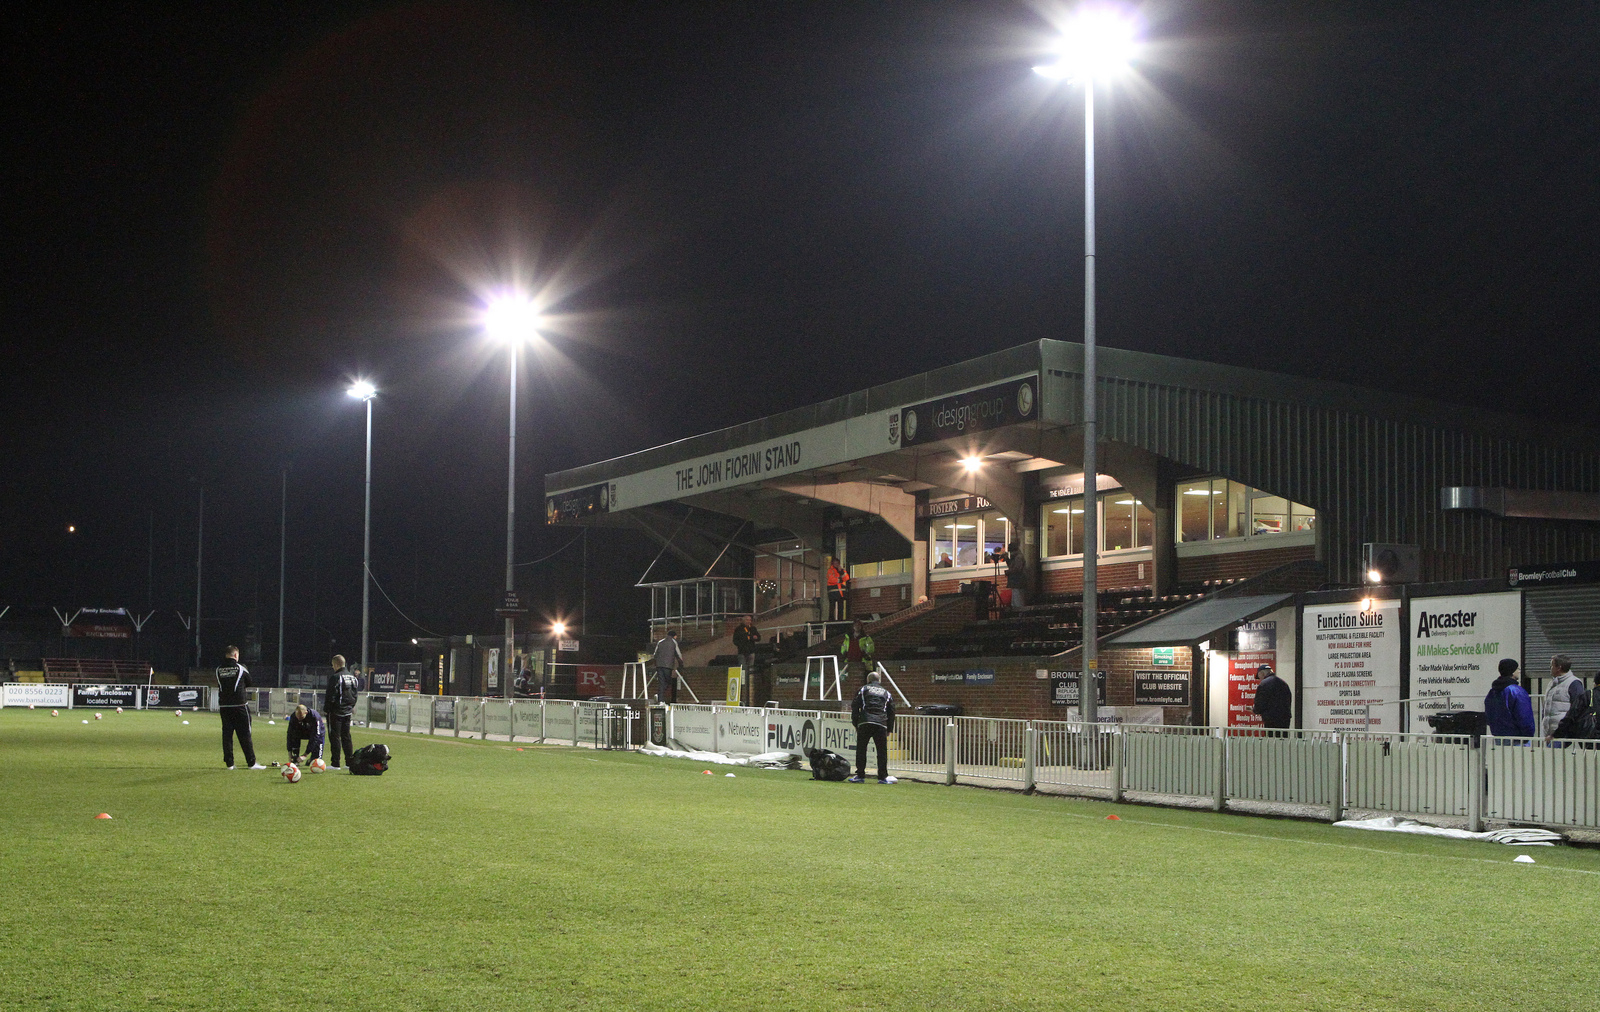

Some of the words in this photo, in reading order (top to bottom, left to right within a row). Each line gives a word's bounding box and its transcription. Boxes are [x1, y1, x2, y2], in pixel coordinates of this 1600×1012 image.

[675, 467, 693, 490] THE
[696, 461, 721, 487] JOHN
[725, 450, 762, 480] FIORINI
[765, 441, 801, 471] STAND
[929, 500, 958, 515] FOSTER'S
[1251, 622, 1275, 630] PLASTER
[1317, 613, 1357, 628] Function
[1359, 611, 1383, 626] Suite
[1417, 609, 1477, 638] Ancaster
[1417, 644, 1427, 656] All
[1427, 643, 1449, 656] Makes
[1450, 642, 1475, 655] Service
[1475, 642, 1482, 654] &
[1482, 641, 1499, 654] MOT
[1163, 673, 1188, 681] OFFICIAL
[1443, 676, 1456, 684] Health
[1158, 683, 1182, 691] WEBSITE
[1238, 683, 1251, 691] August,
[1418, 689, 1428, 697] Free
[1428, 689, 1437, 697] Tyre
[1437, 689, 1451, 697] Checks
[728, 721, 760, 737] Networkers
[767, 723, 795, 750] FILA
[802, 728, 815, 749] JD
